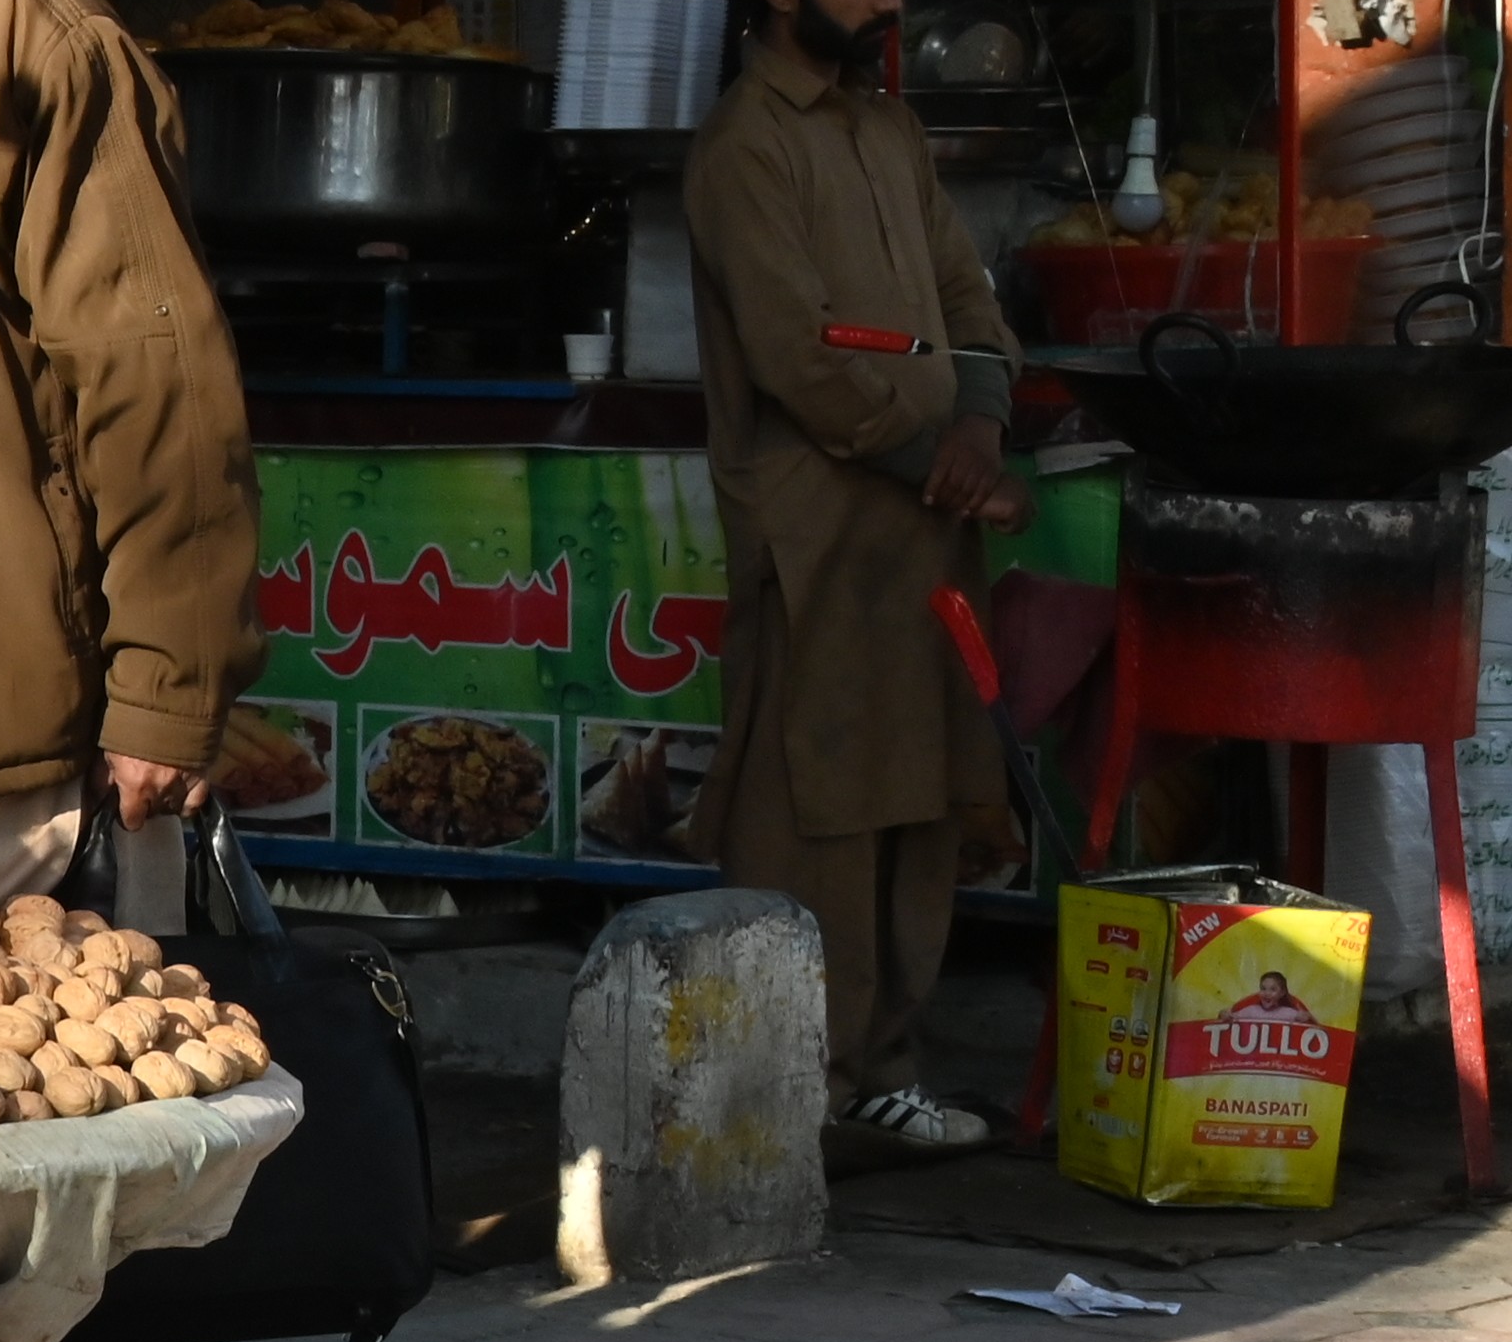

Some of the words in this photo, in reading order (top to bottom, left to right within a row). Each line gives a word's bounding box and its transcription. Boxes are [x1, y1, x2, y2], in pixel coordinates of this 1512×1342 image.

[257, 526, 572, 680] سموس
[1182, 911, 1221, 947] NEW
[1202, 1022, 1330, 1059] TULLO
[1205, 1097, 1309, 1118] BANASPATI
